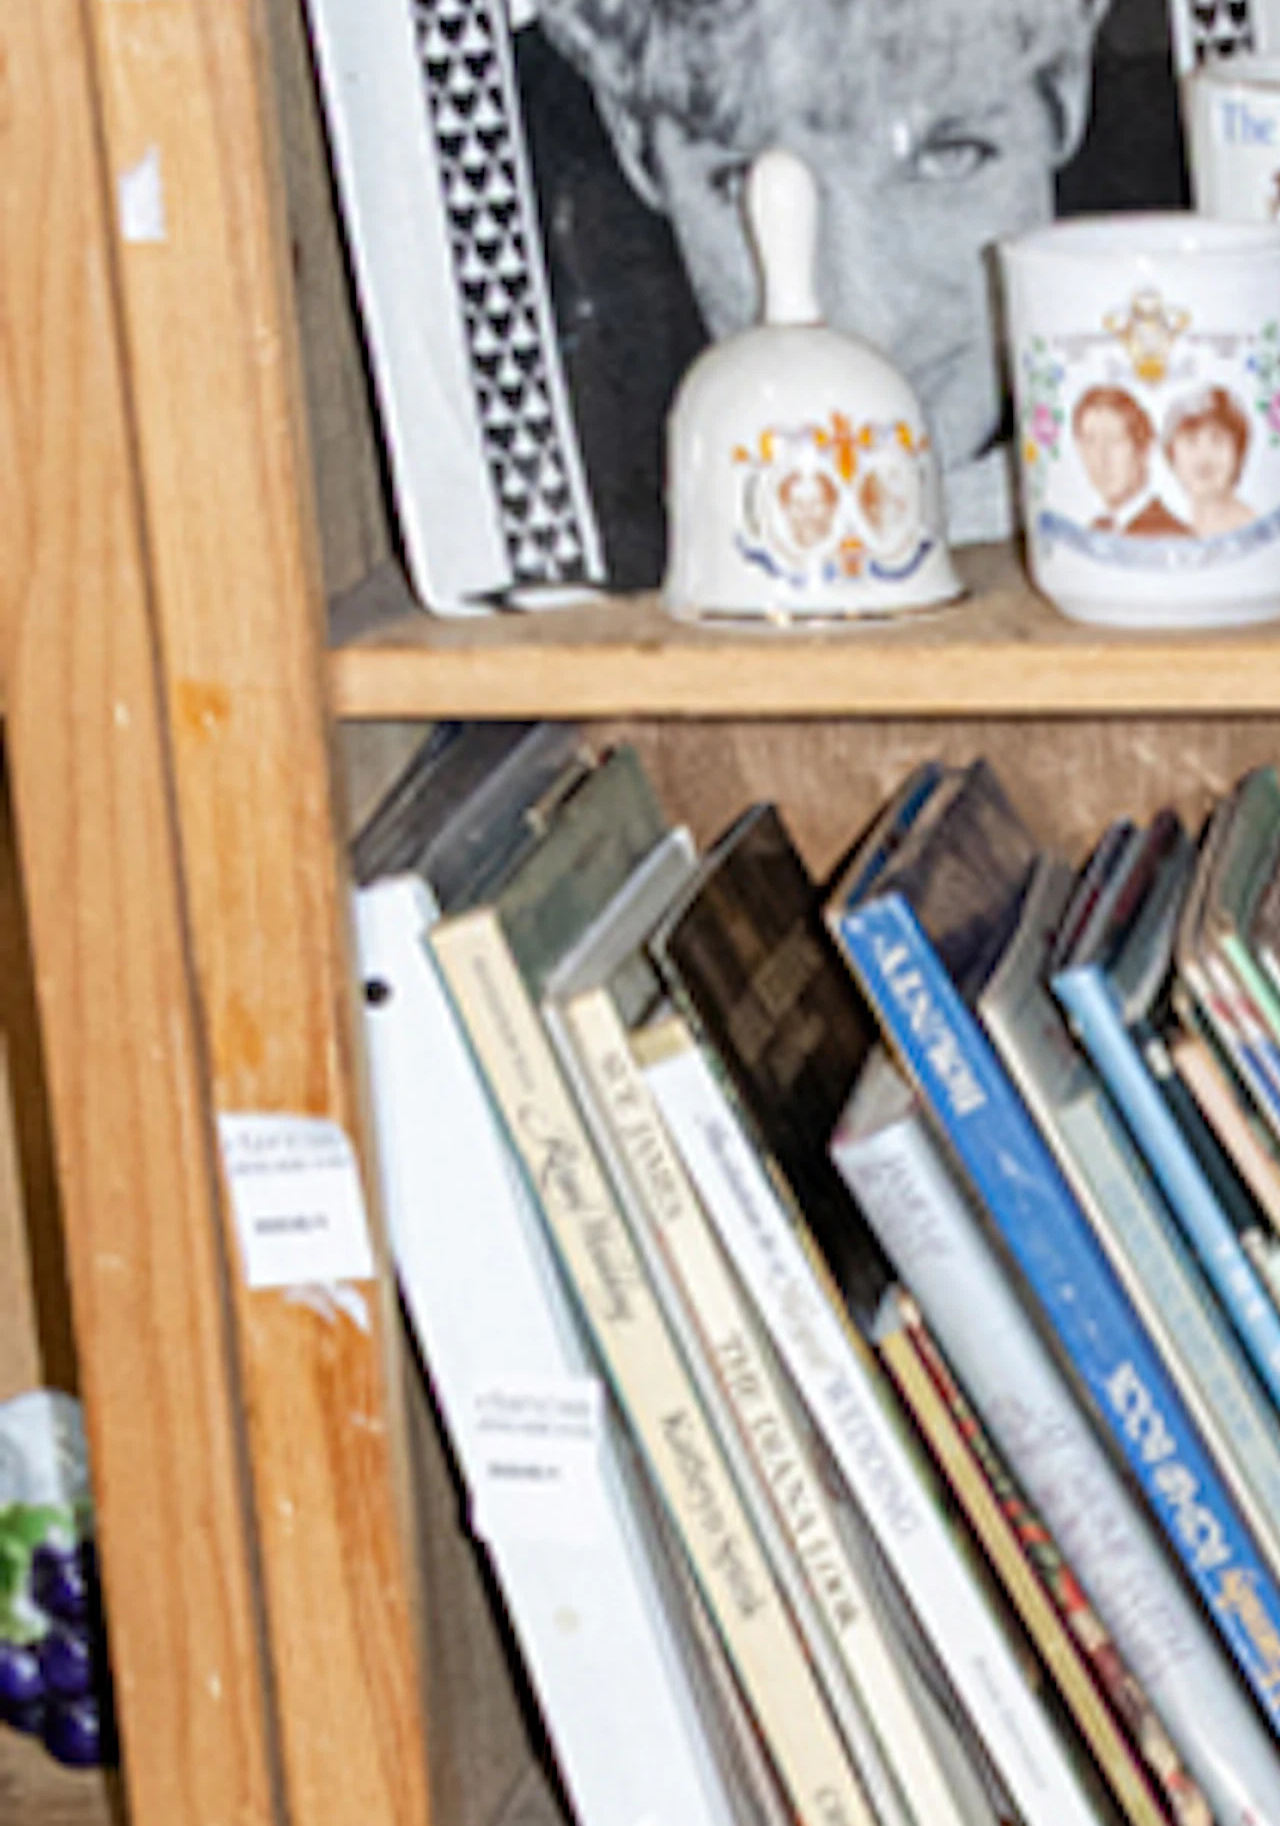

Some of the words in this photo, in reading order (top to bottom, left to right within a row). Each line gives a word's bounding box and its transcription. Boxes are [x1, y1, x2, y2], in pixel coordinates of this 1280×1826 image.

[1218, 102, 1276, 147] The
[860, 924, 993, 1120] BOUNTY
[714, 1332, 770, 1407] THE
[746, 1410, 825, 1536] DIANA
[799, 1531, 865, 1632] LOOK
[817, 1374, 924, 1539] WEDDING
[1093, 1359, 1179, 1467] BOOK
